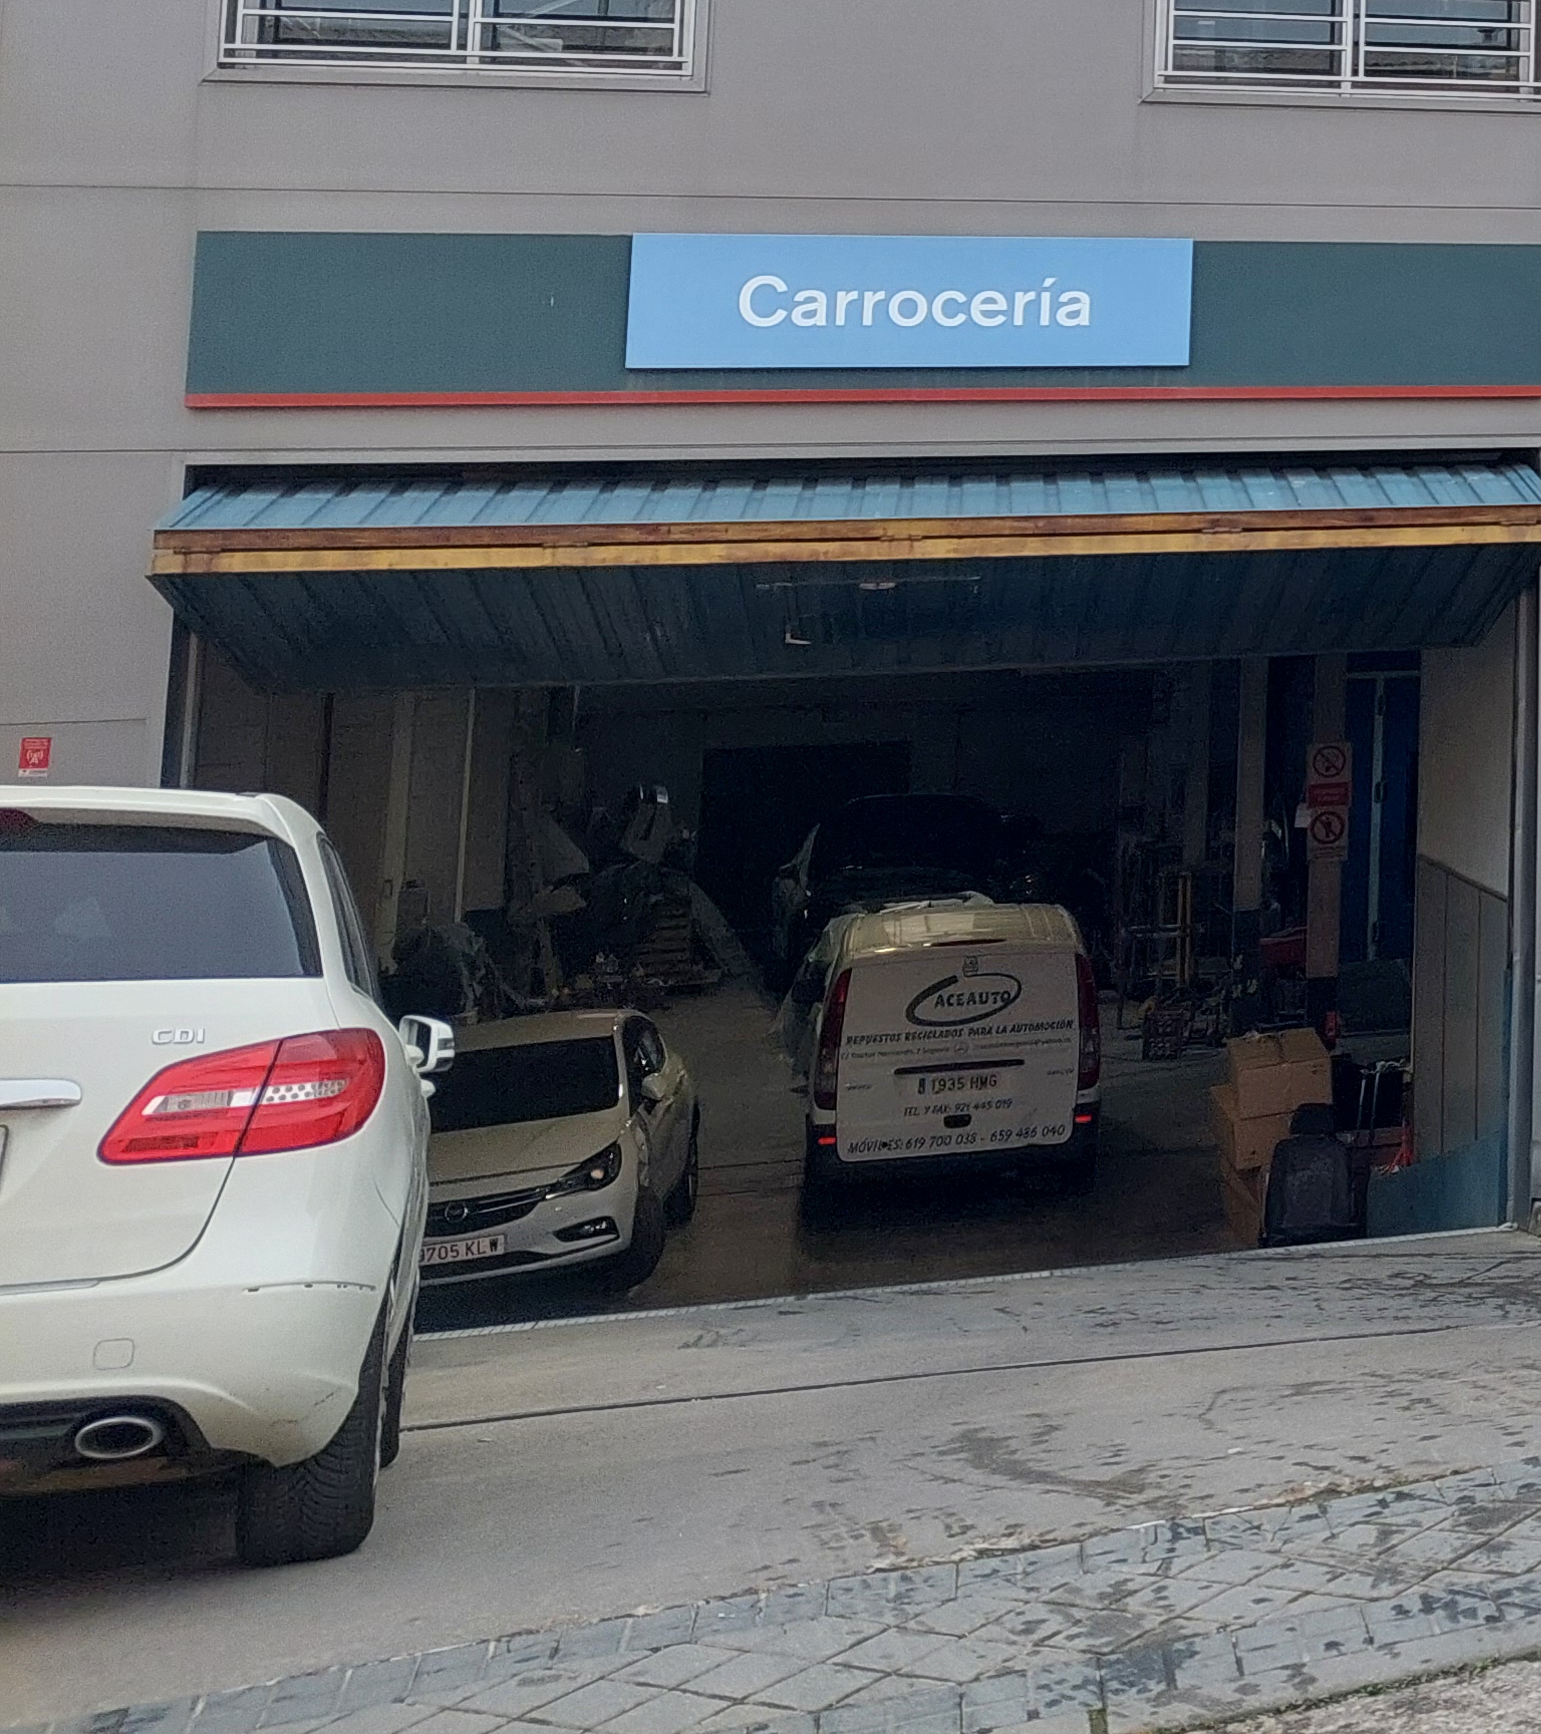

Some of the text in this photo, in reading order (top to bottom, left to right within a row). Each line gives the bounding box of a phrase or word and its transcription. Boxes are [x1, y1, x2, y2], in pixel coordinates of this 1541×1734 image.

[738, 274, 1092, 328] Carrocería
[934, 991, 1012, 1008] ACEAUTO
[152, 1028, 205, 1045] CDI
[904, 1028, 964, 1043] RECICLADOS
[968, 1025, 993, 1037] PARA
[996, 1025, 1007, 1035] LA
[905, 1136, 926, 1151] 619
[930, 1134, 952, 1148] 700
[990, 1129, 1013, 1143] 659
[466, 1238, 499, 1257] KLW
